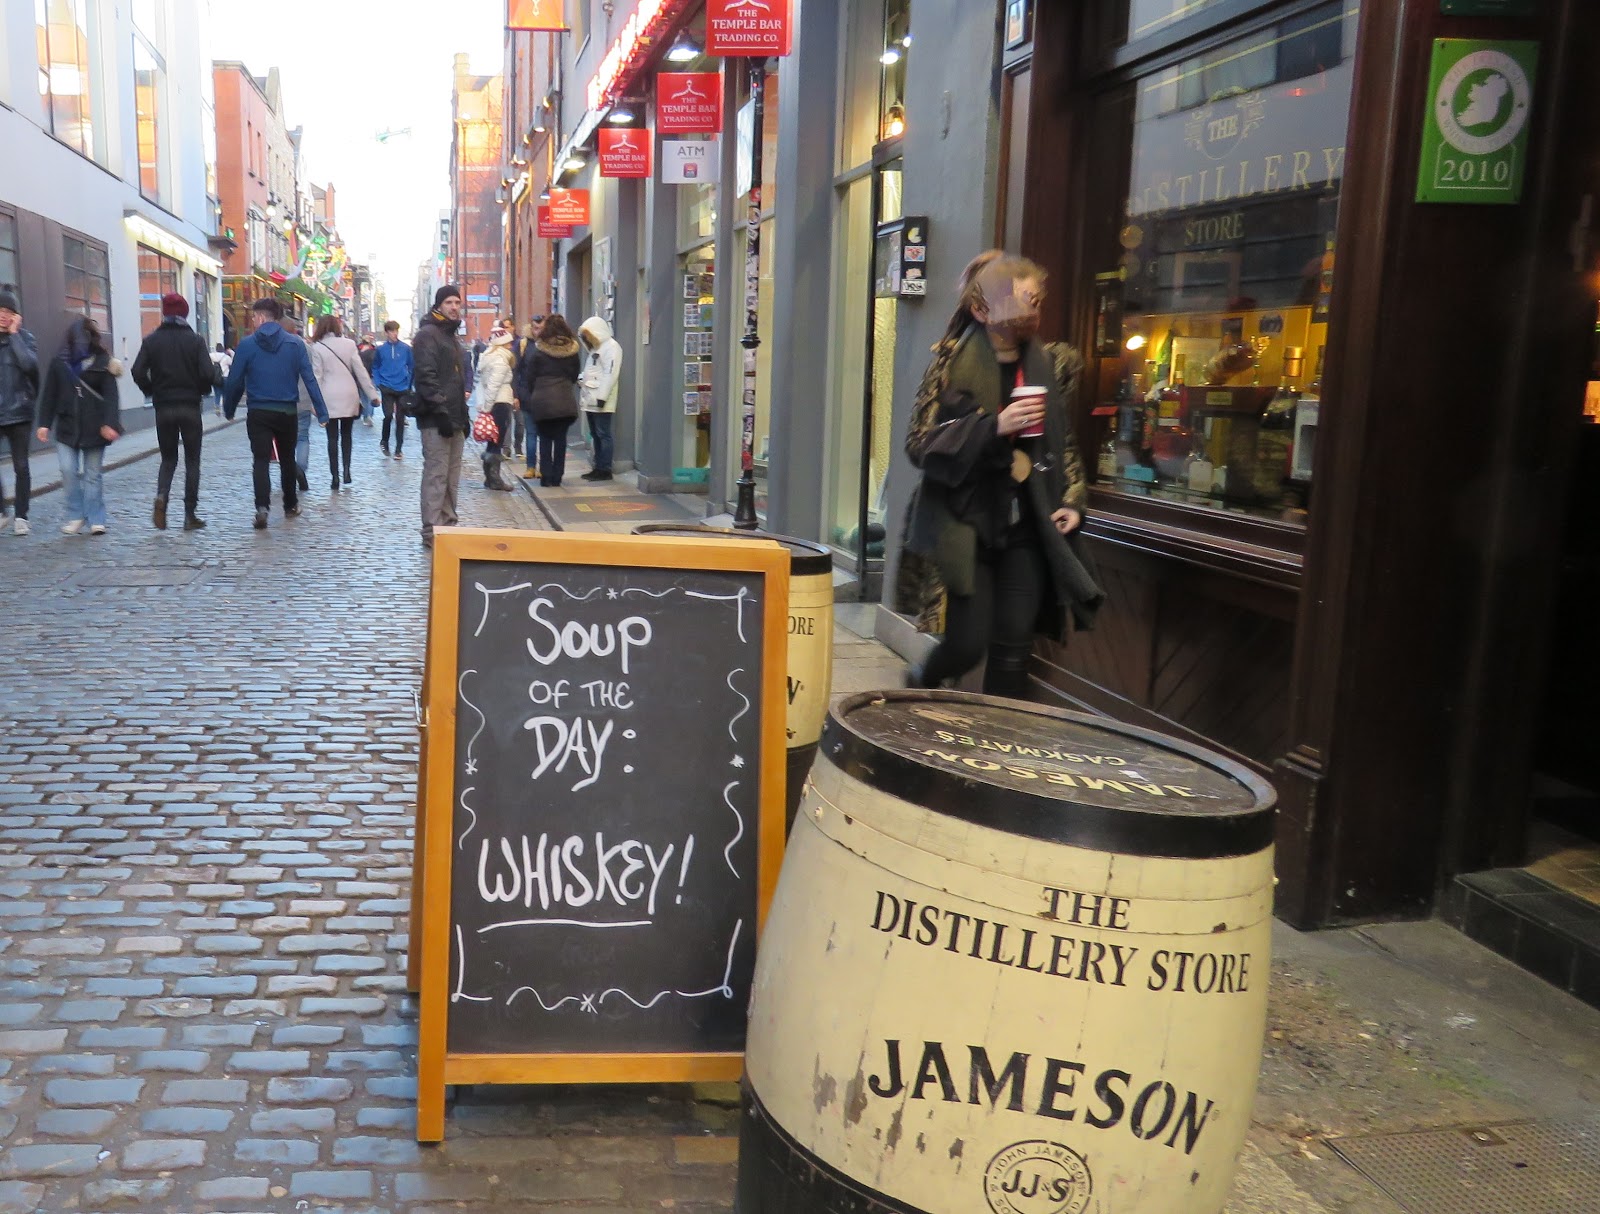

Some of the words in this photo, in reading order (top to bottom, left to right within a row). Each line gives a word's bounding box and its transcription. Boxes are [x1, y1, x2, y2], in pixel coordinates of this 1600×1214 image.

[712, 19, 757, 30] TEMPLE
[759, 19, 782, 30] BAR
[737, 9, 758, 18] THE
[715, 33, 761, 42] TRADING
[763, 34, 779, 42] CO.
[661, 105, 697, 113] TEMPLE
[698, 105, 717, 113] BAR
[1207, 114, 1238, 143] THE
[602, 154, 631, 162] TEMPLE
[631, 154, 646, 162] BAR
[677, 146, 705, 156] ATM
[1441, 160, 1509, 182] 2010
[1184, 212, 1246, 246] STORE
[788, 616, 815, 636] ORE
[528, 680, 570, 709] OF
[580, 681, 634, 710] THE
[935, 730, 1127, 766] CASKMATES
[921, 749, 1197, 798] JAMESON
[1042, 887, 1131, 930] THE
[870, 890, 1139, 987] DISTILLERY
[1146, 949, 1252, 994] STORE
[868, 1039, 1215, 1155] JAMESON
[995, 1147, 1028, 1175] JOHN
[1034, 1146, 1086, 1190] JAMESON
